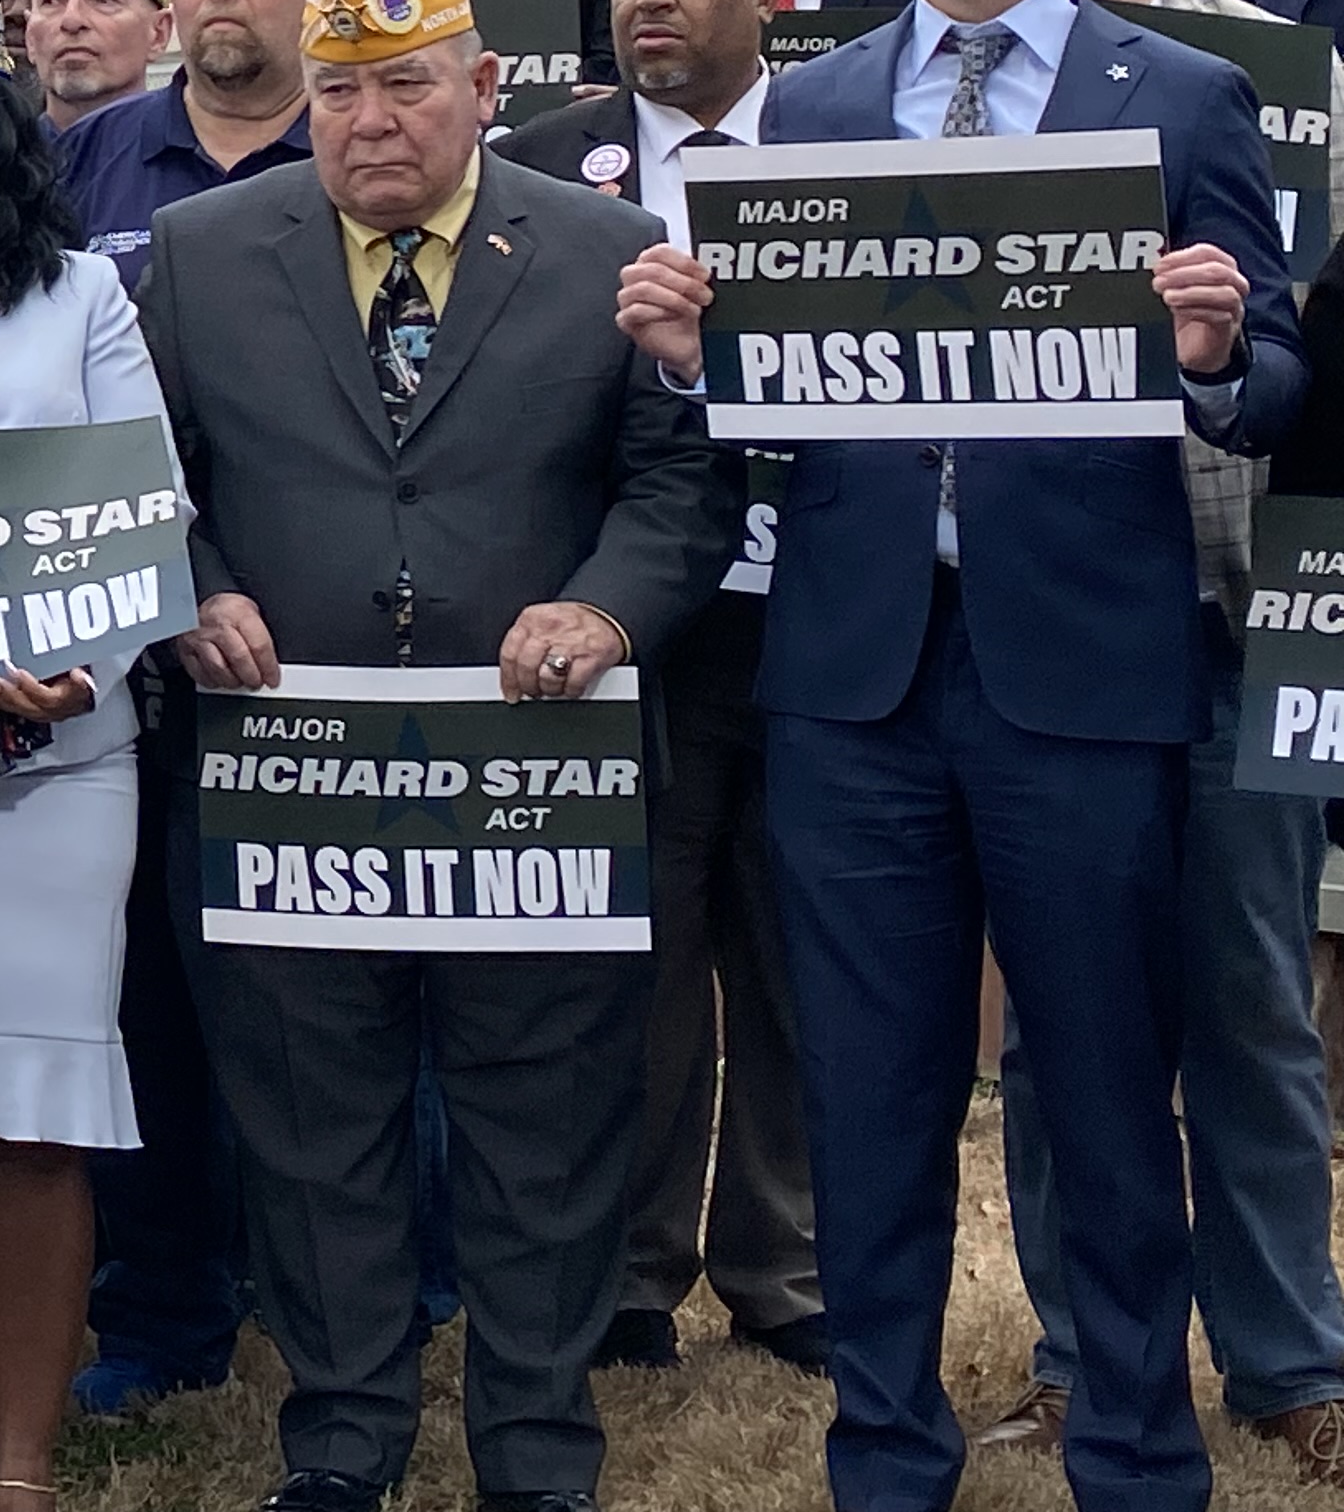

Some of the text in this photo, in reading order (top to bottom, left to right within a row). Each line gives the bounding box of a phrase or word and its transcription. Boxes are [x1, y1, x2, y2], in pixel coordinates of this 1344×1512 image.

[770, 37, 837, 52] MAJOR
[498, 53, 583, 85] TAR
[1259, 105, 1330, 145] AR
[737, 199, 849, 225] MAJOR
[697, 230, 1166, 281] RICHARD STAR
[1000, 284, 1072, 311] ACT
[738, 326, 1138, 404] PASS IT NOW
[22, 489, 178, 547] STAR
[31, 546, 97, 577] ACT
[21, 564, 162, 656] NOW
[241, 715, 346, 742] MAJOR
[1272, 686, 1344, 762] PA
[199, 752, 640, 798] RICHARD STAR
[484, 806, 551, 831] ACT
[235, 841, 612, 917] PASS IT NOW
